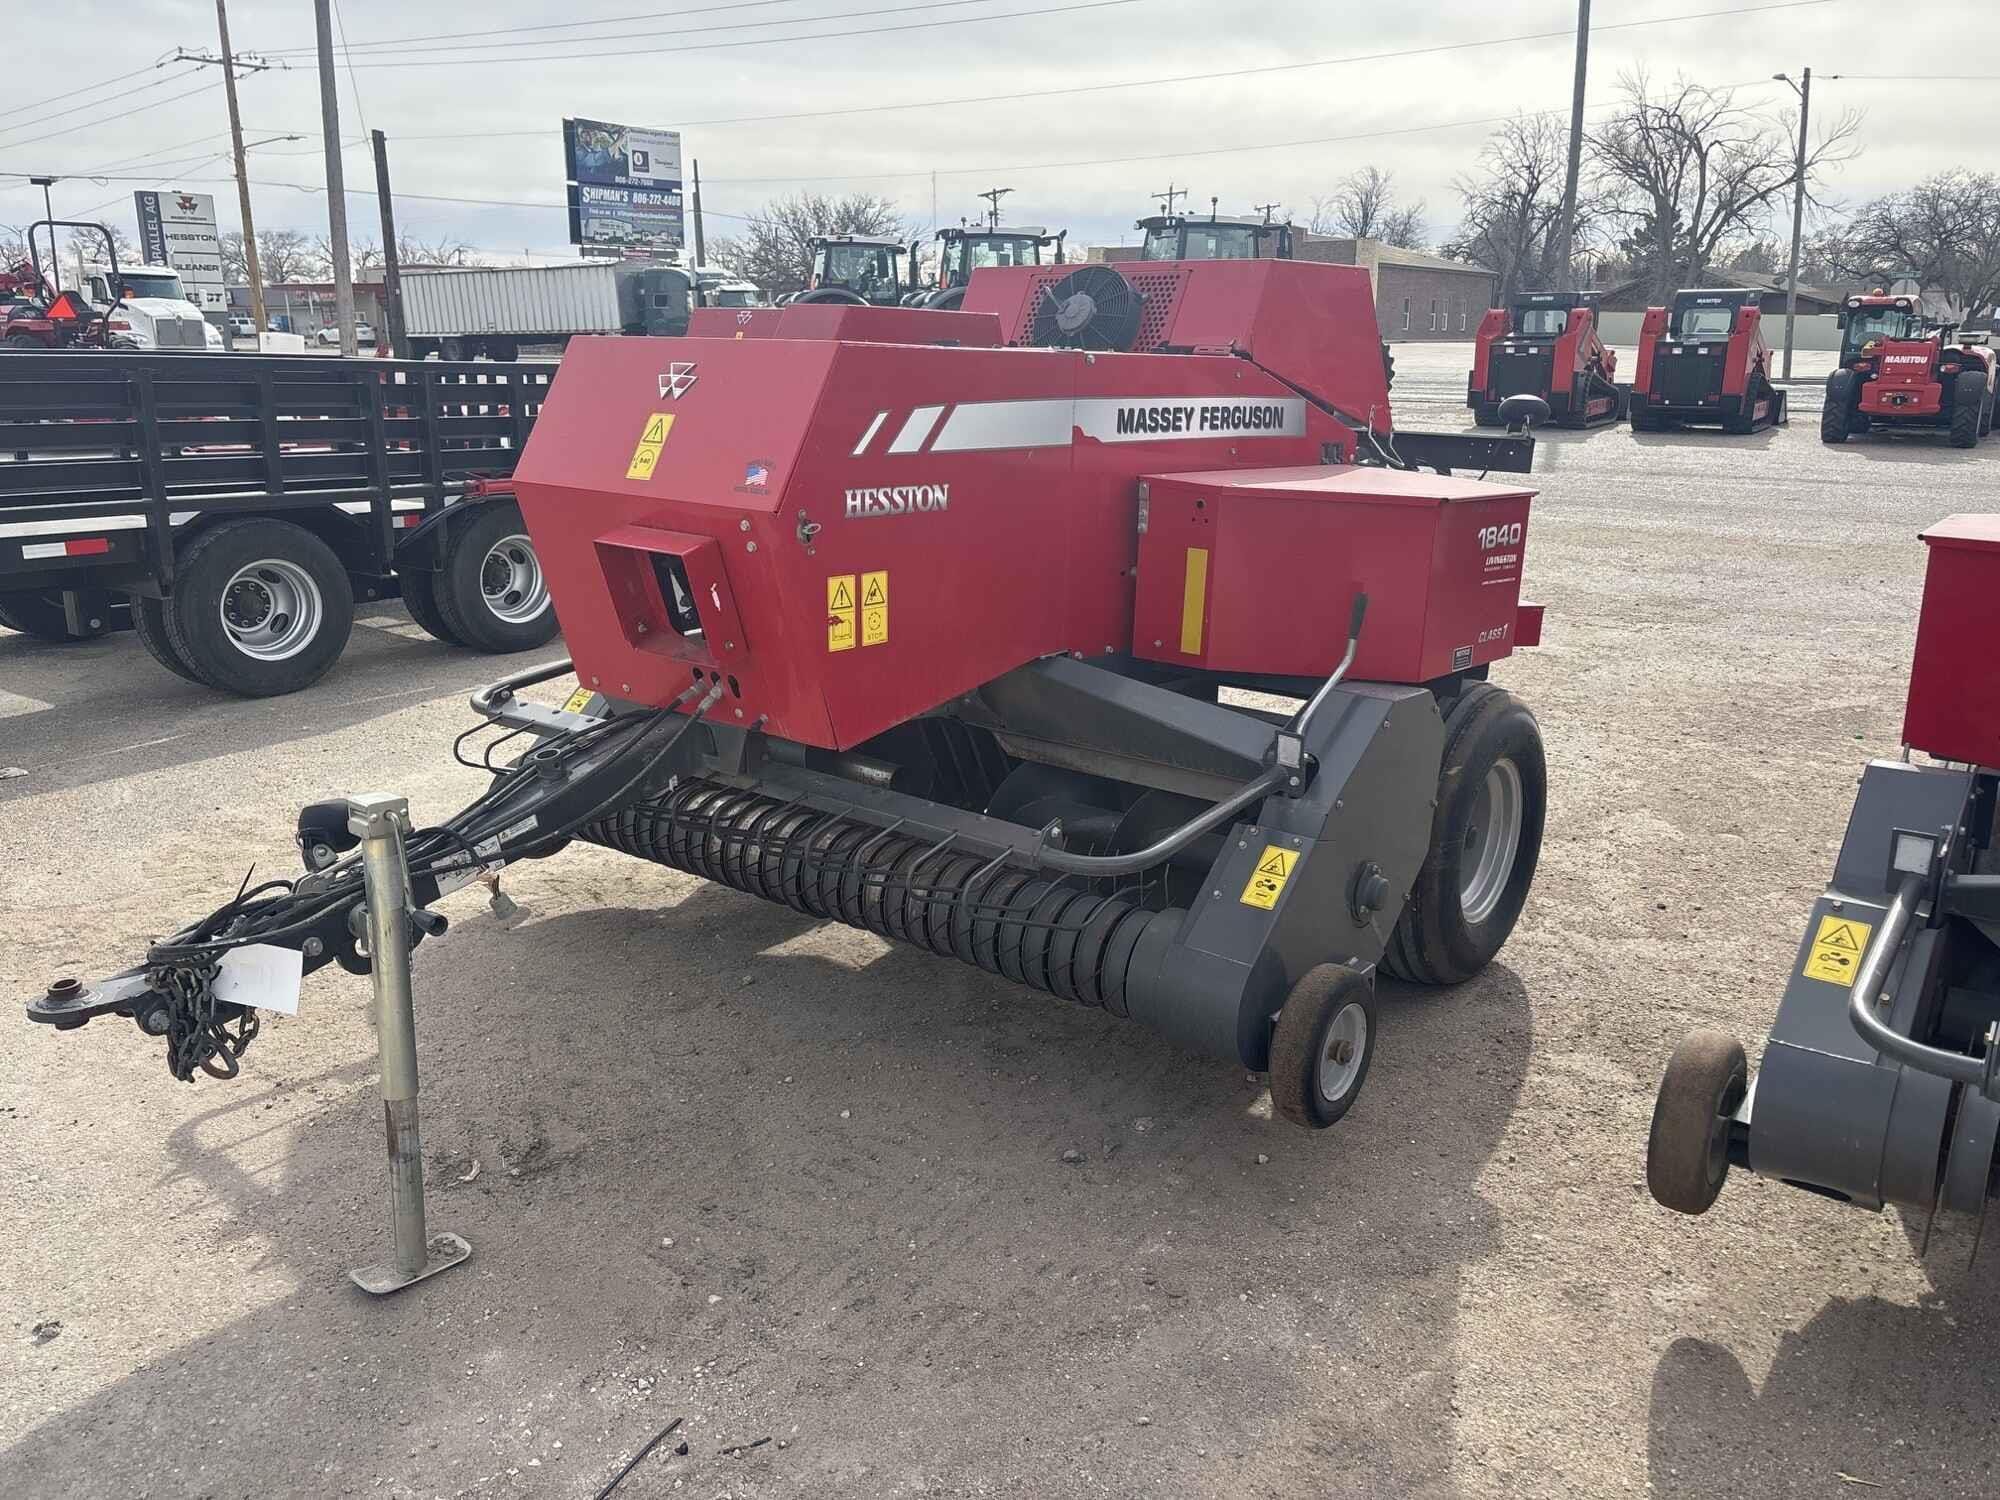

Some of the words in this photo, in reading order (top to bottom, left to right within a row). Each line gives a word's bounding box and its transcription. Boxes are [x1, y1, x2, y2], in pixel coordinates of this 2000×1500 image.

[582, 186, 629, 203] SHIPMAN'S
[144, 196, 157, 214] AG
[165, 233, 216, 242] HESSTON
[1884, 355, 1928, 364] MANITOU
[1116, 406, 1195, 434] MASSEY
[1199, 405, 1285, 431] FERGUSON
[844, 483, 950, 518] HESSTON
[1478, 522, 1522, 550] 1840
[1478, 627, 1502, 644] CLASS
[1502, 623, 1509, 640] 1
